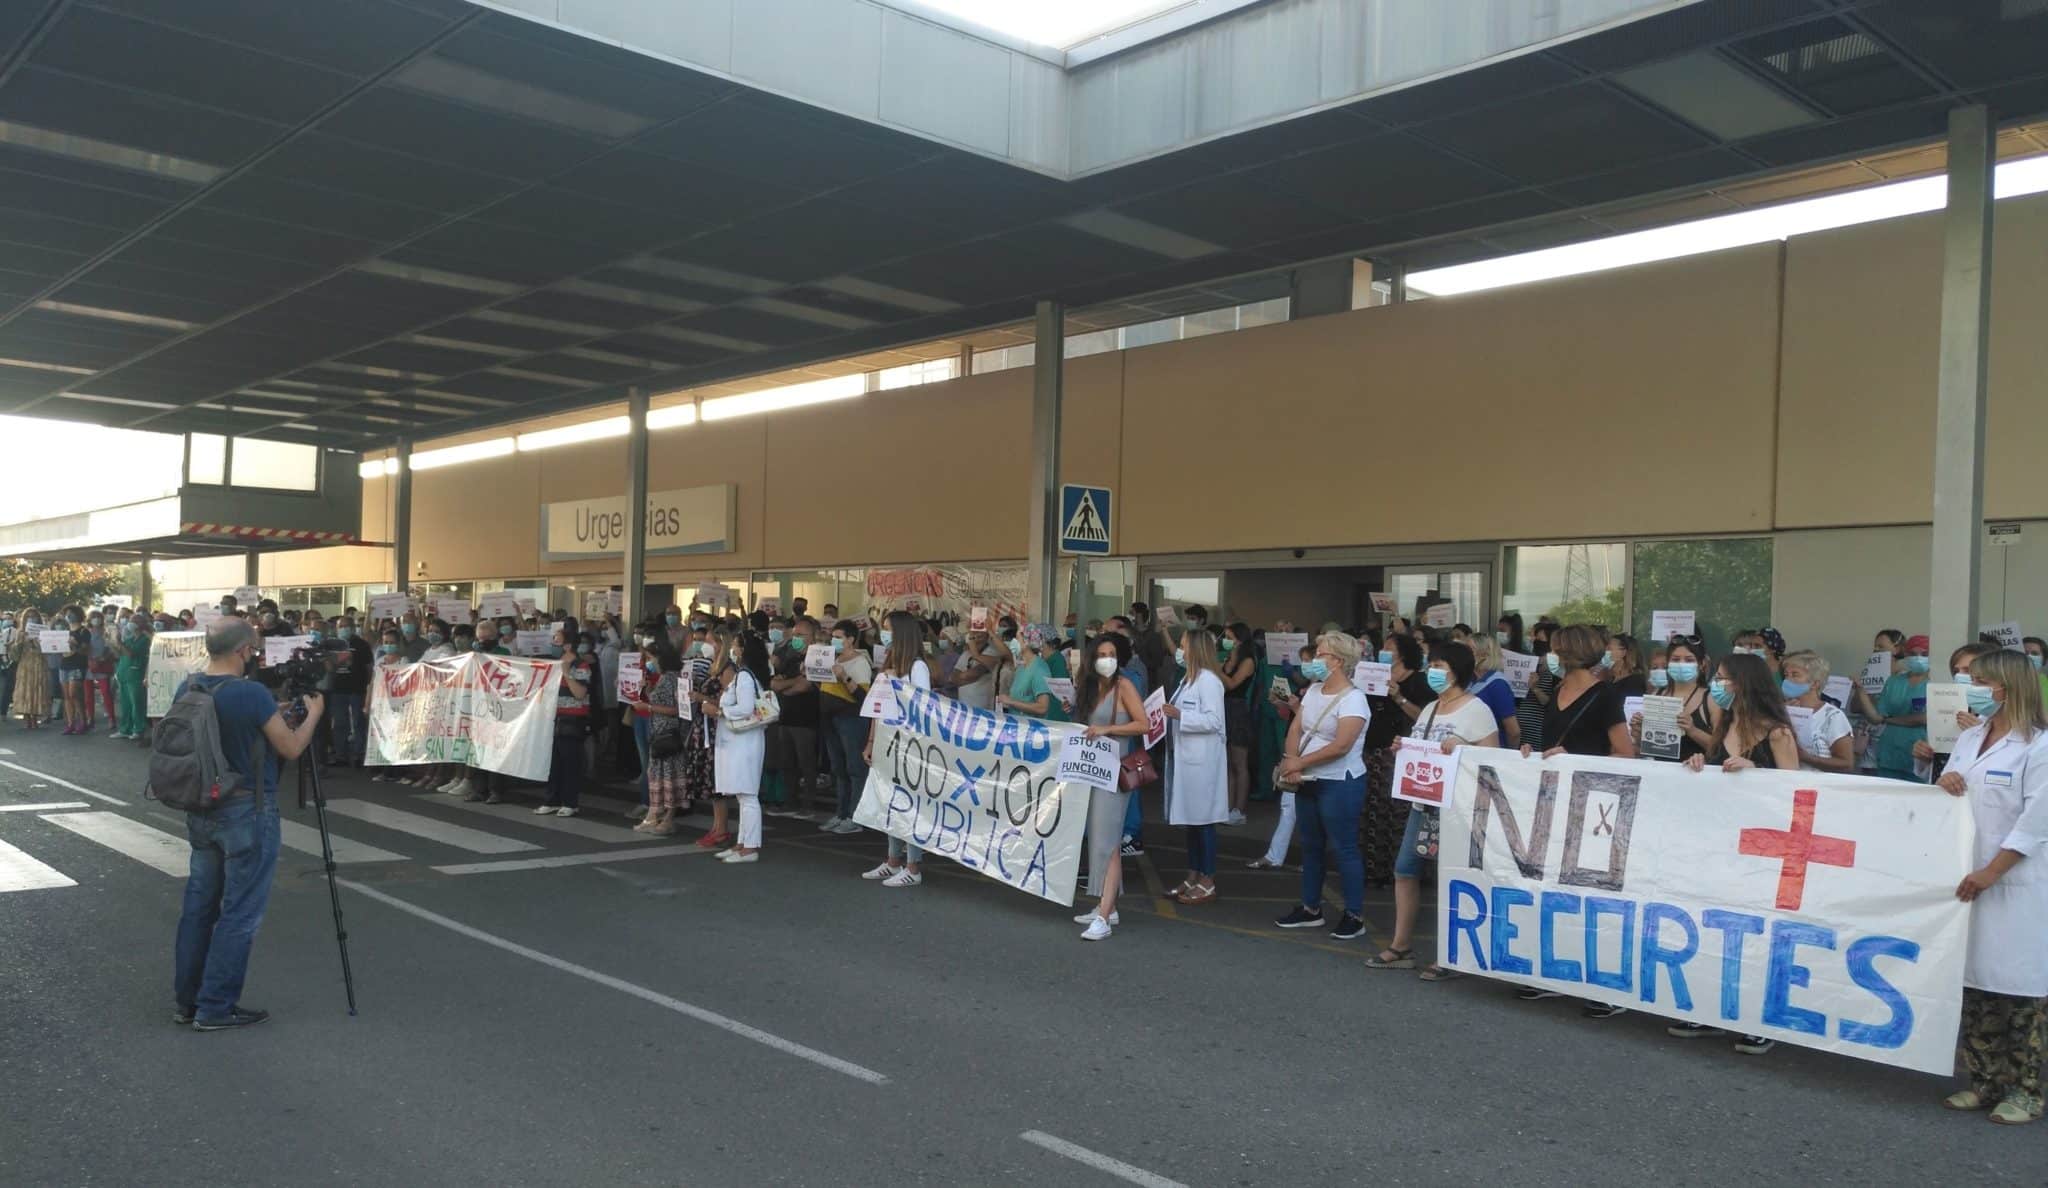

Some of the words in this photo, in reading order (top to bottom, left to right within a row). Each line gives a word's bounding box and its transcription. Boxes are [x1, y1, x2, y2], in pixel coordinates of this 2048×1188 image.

[575, 501, 681, 548] Urgeias
[884, 679, 1050, 763] SANIDAD
[1069, 736, 1093, 748] ESTO
[1062, 761, 1112, 781] FUNCIONA
[1080, 750, 1096, 763] NO
[1469, 765, 1642, 892] NO
[1448, 879, 1921, 1049] RECORTES
